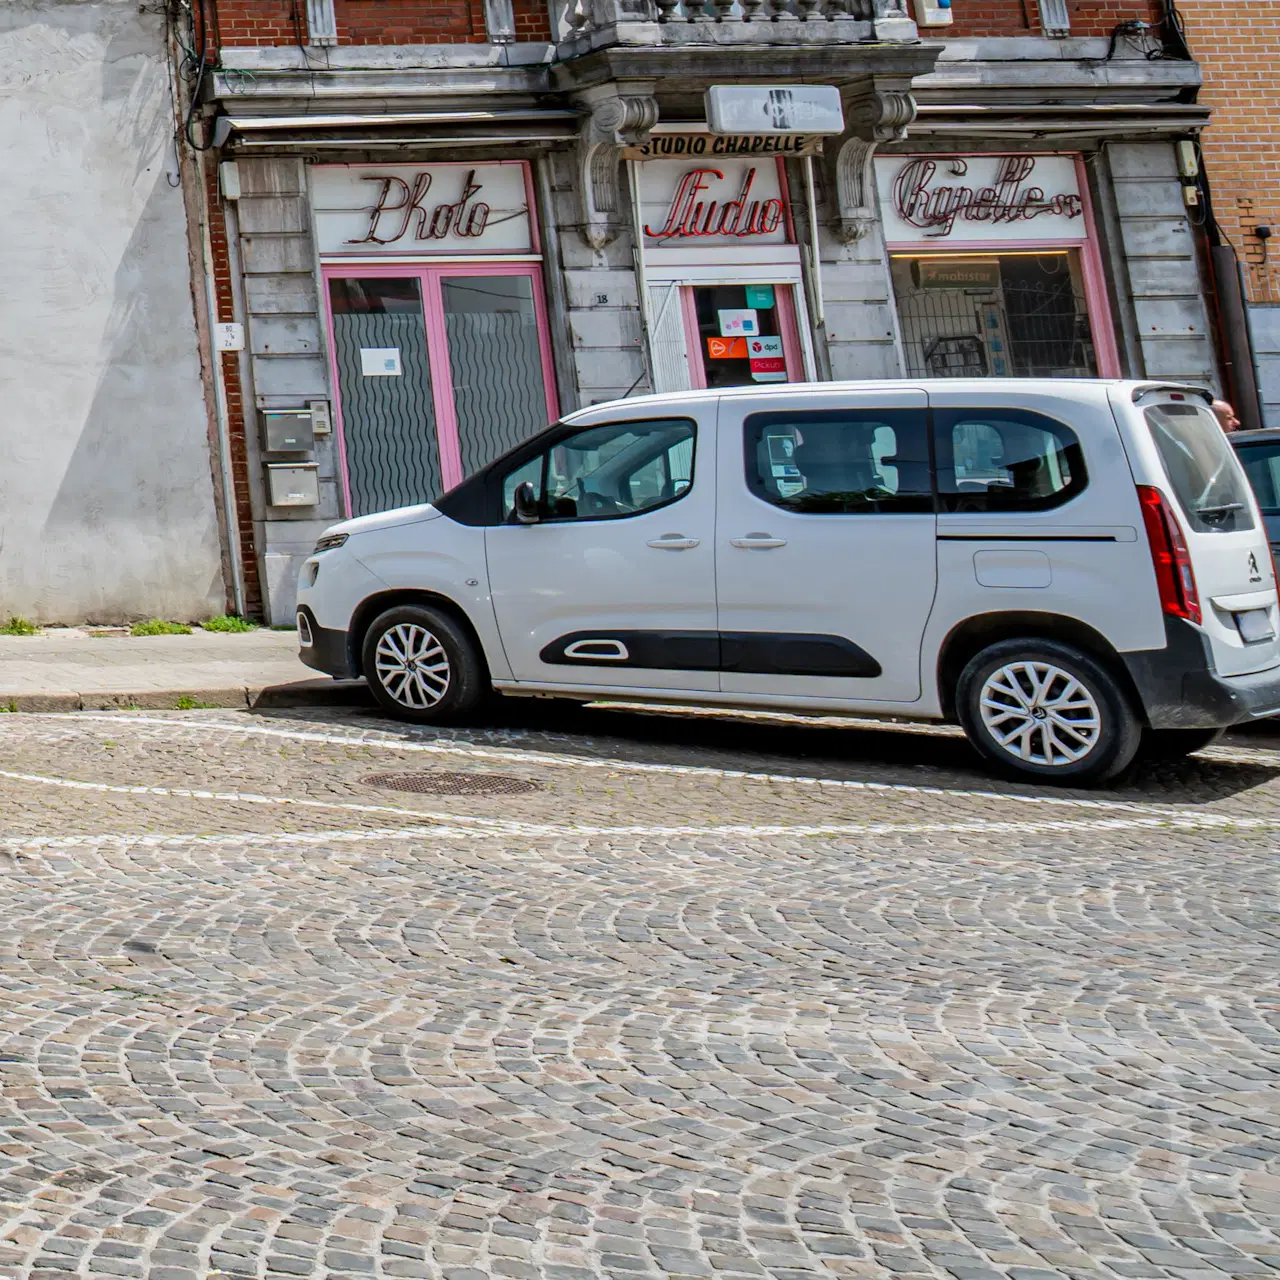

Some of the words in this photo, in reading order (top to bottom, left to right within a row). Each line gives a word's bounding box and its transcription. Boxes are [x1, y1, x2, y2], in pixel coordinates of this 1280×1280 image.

[712, 134, 806, 154] CHAPELLE
[342, 169, 490, 245] Photo
[644, 168, 785, 238] Studio
[938, 270, 990, 282] mobistar
[597, 295, 608, 304] 18
[764, 343, 779, 352] dpd
